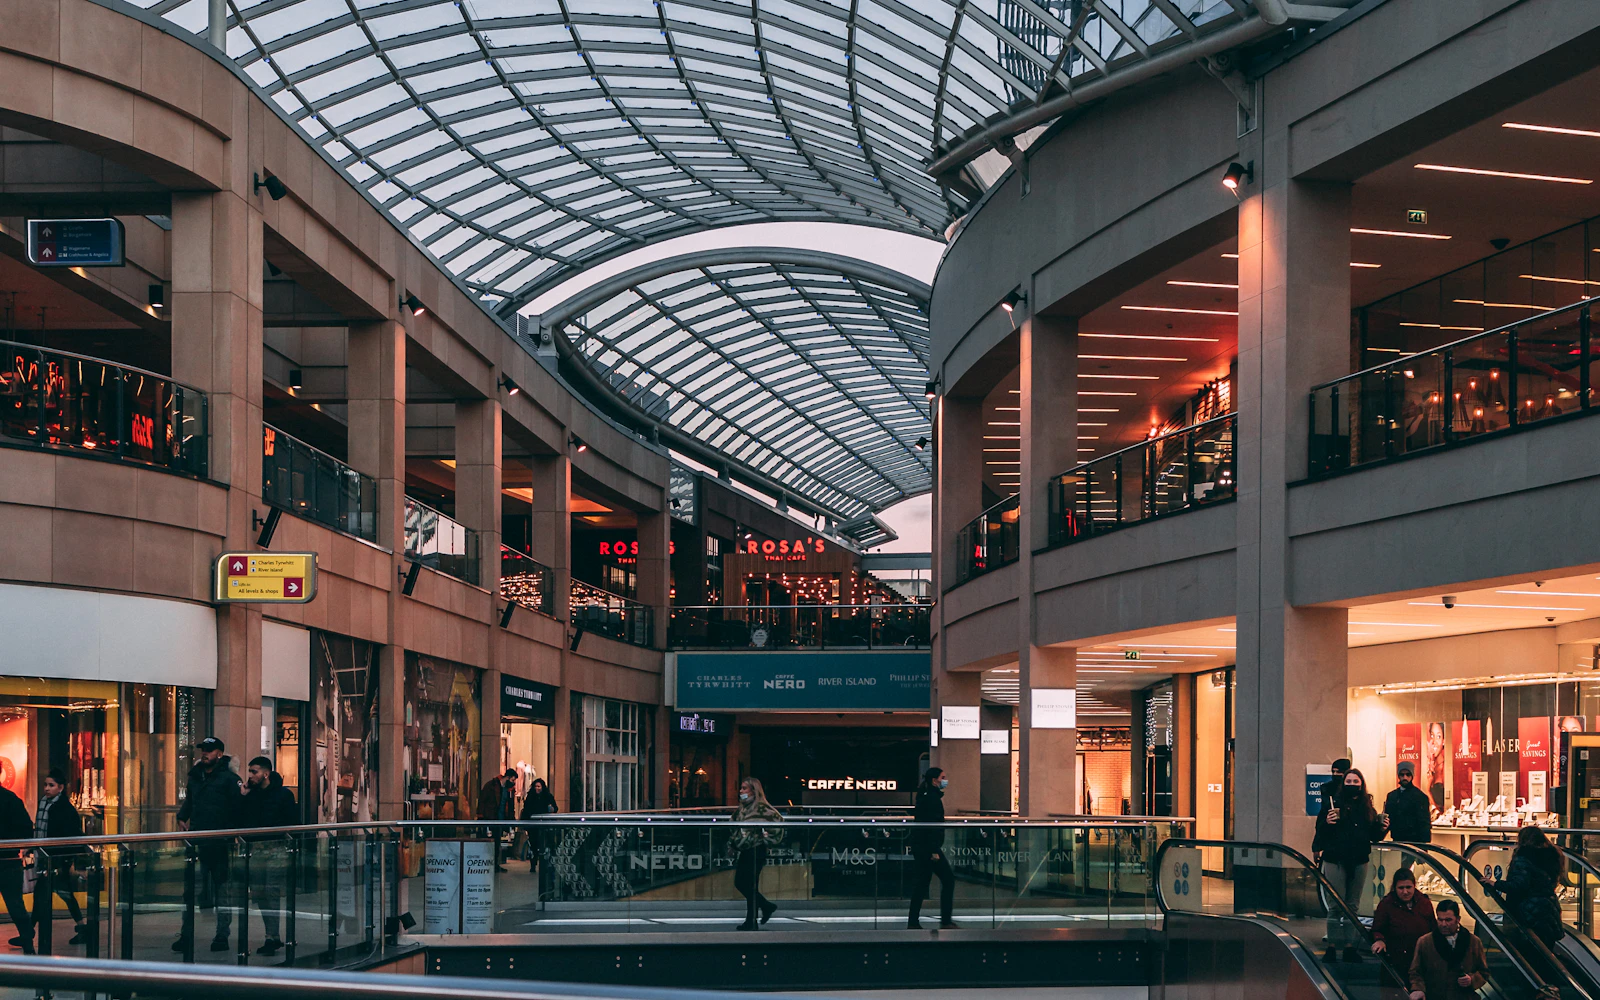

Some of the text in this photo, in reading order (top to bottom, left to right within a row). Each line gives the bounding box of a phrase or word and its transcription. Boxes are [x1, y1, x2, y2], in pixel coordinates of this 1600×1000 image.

[747, 537, 825, 554] ROSA'S
[763, 679, 806, 689] NERO
[808, 776, 896, 790] CAFFÈ NERO
[832, 847, 876, 866] M&S
[950, 846, 991, 856] STONER
[998, 851, 1031, 862] RIVER
[630, 854, 703, 870] NERO
